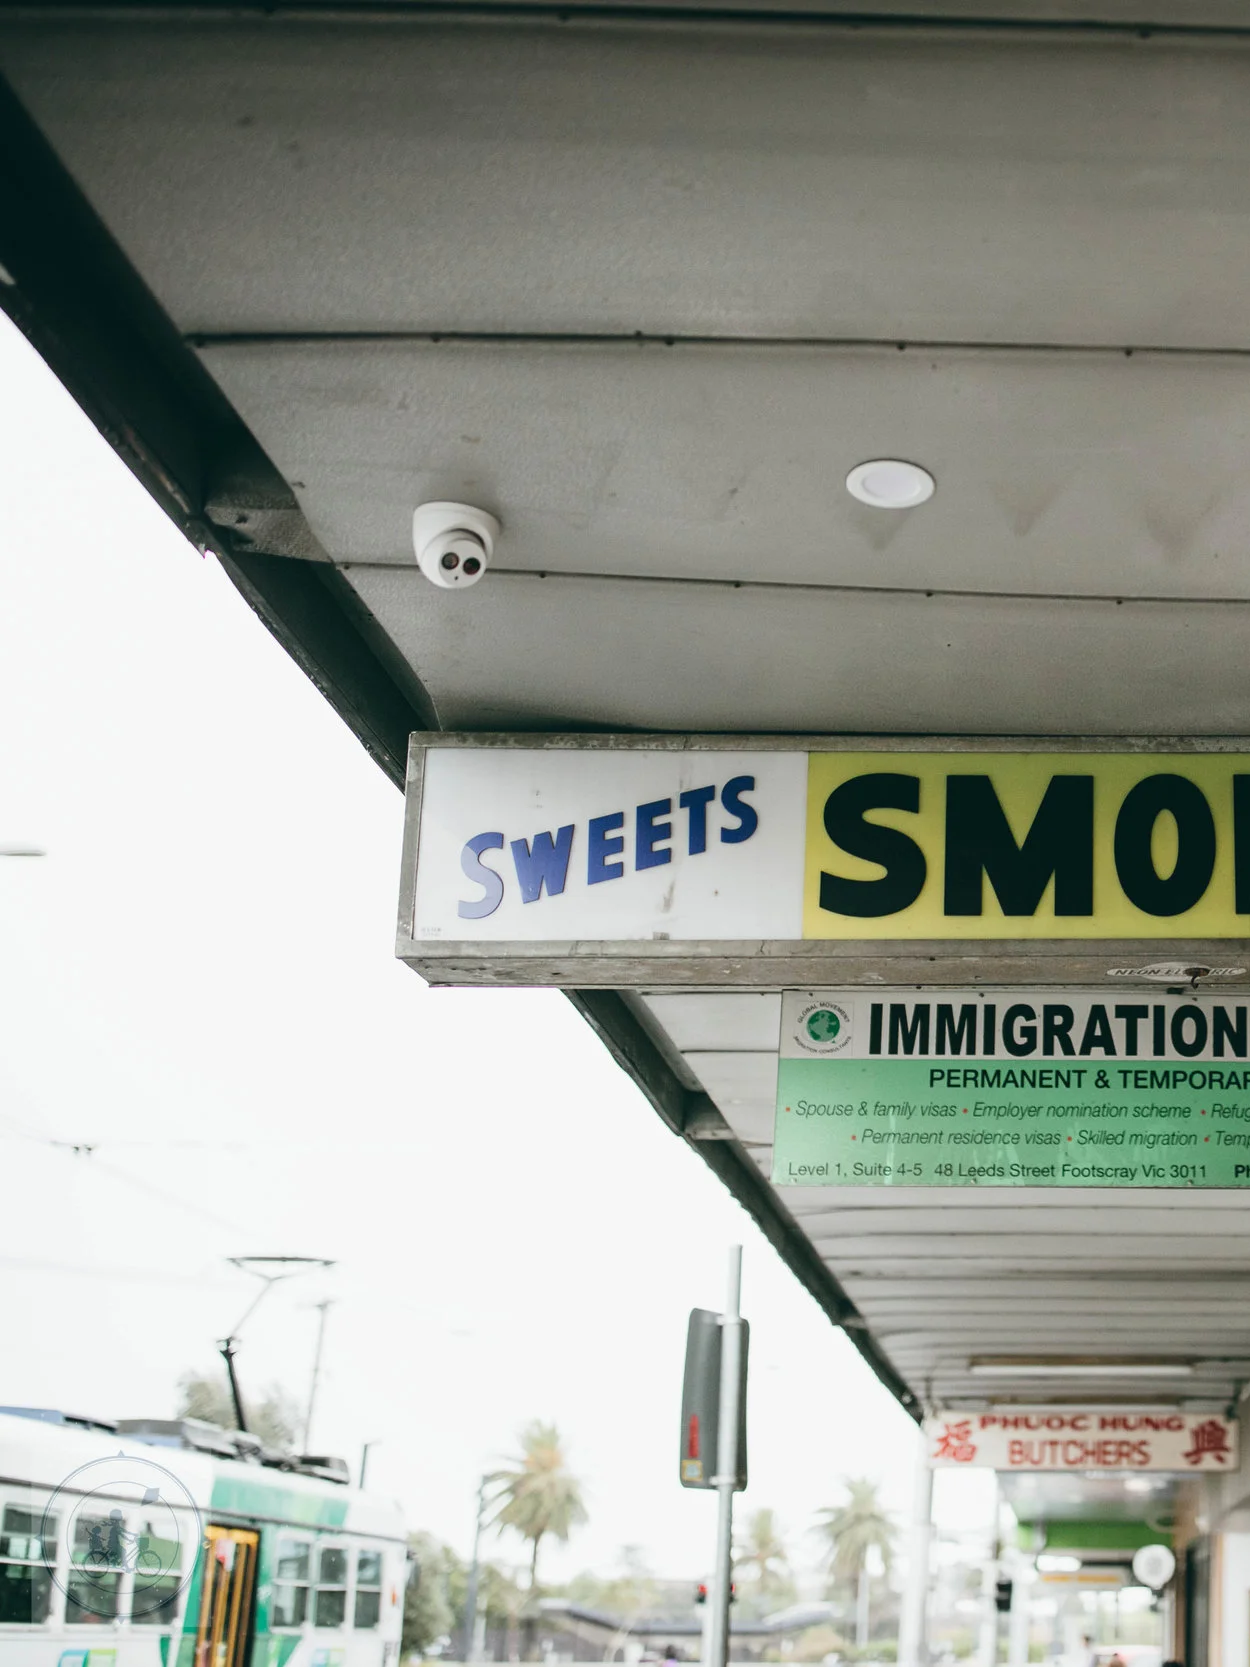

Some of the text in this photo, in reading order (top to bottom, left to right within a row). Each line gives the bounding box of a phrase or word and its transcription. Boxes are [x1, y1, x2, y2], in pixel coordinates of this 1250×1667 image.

[457, 775, 758, 919] SWEETS
[797, 1003, 818, 1024] GLOBAL
[868, 1003, 1248, 1058] IMMIGRATION
[929, 1069, 1087, 1089] PERMANENT
[1094, 1070, 1111, 1089] &
[795, 1101, 853, 1118] Spouse
[858, 1102, 868, 1116] &
[872, 1101, 915, 1119] family
[918, 1103, 957, 1117] visas
[973, 1102, 1043, 1120] Employer
[1046, 1103, 1129, 1118] nomination
[1132, 1104, 1191, 1119] scheme
[861, 1129, 943, 1145] Permanent
[947, 1129, 1021, 1145] residence
[1024, 1131, 1061, 1145] visas
[1077, 1130, 1124, 1145] Skilled
[1129, 1130, 1197, 1149] migration
[788, 1162, 829, 1176] Level
[853, 1163, 892, 1177] Suite
[896, 1163, 923, 1177] 4-5
[934, 1164, 953, 1177] 48
[959, 1164, 1004, 1178] Leeds
[1010, 1164, 1055, 1178] Street
[1061, 1165, 1137, 1182] Footscray
[1141, 1165, 1165, 1178] Vic
[1169, 1165, 1207, 1179] 3011
[978, 1413, 1186, 1432] PHUOC HUNG
[1007, 1439, 1151, 1466] BUTCHERS
